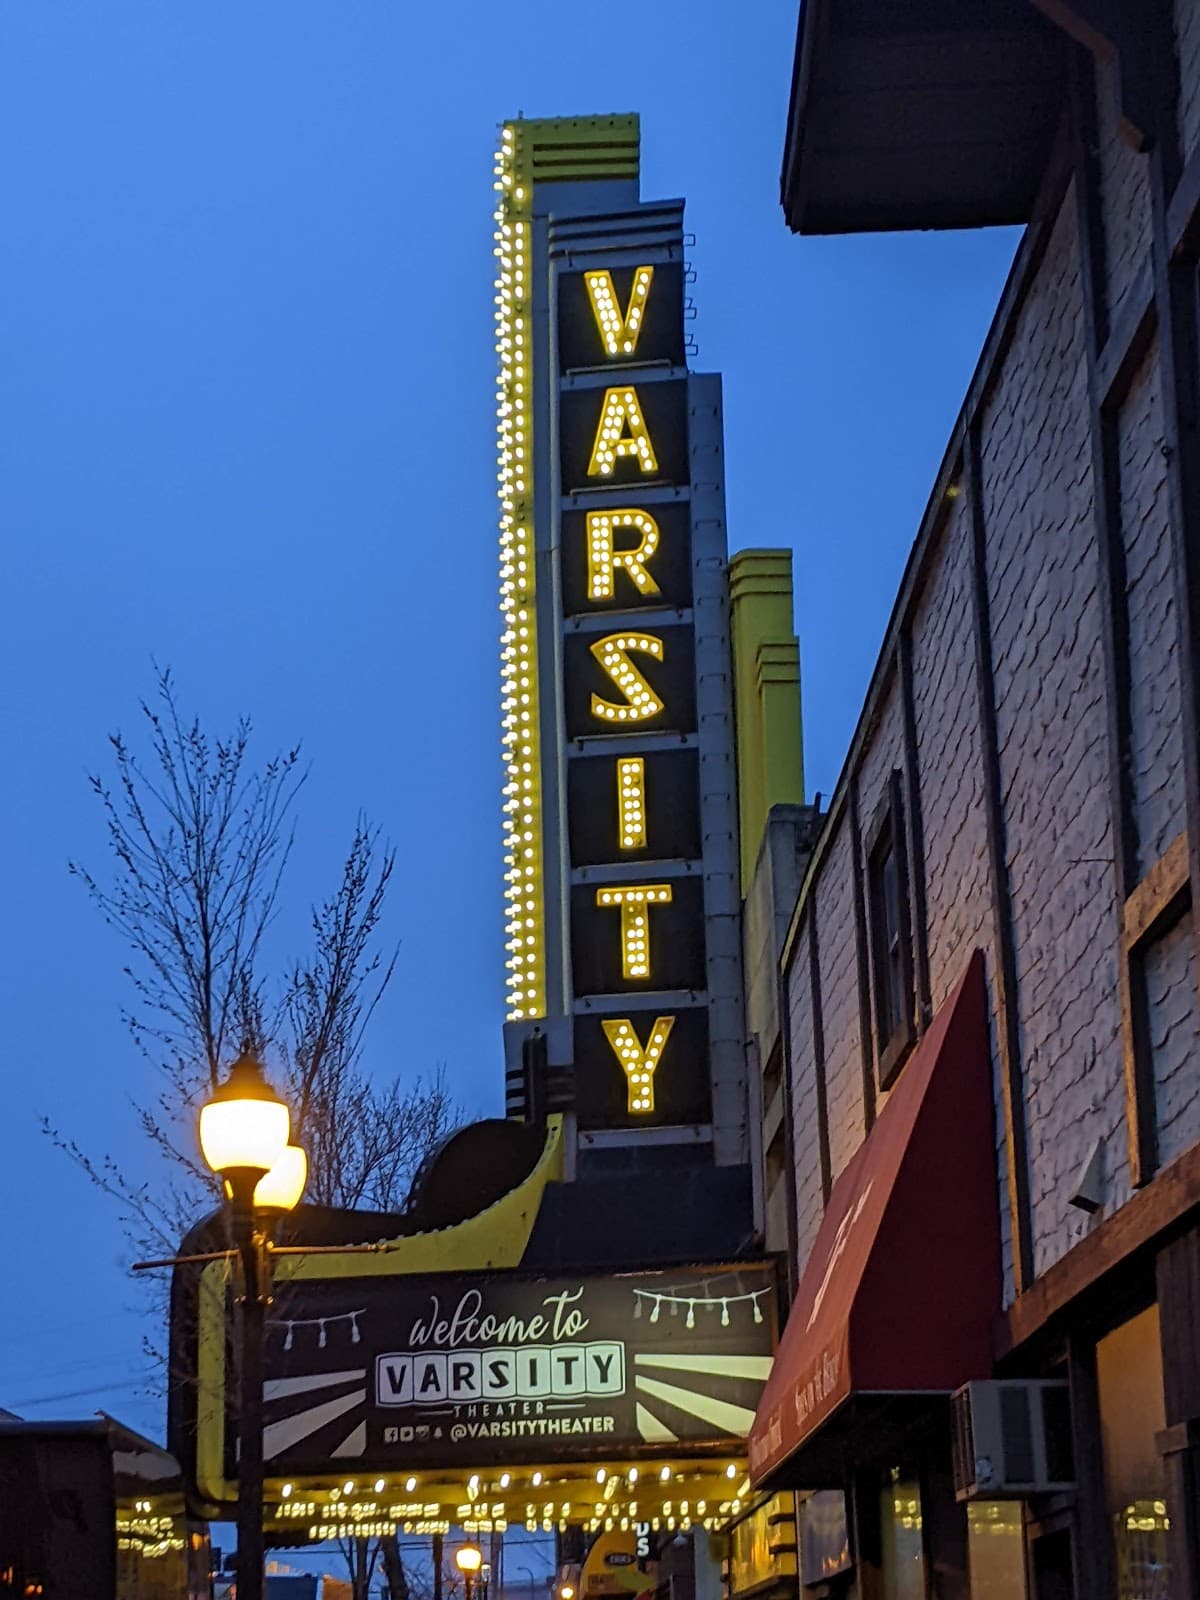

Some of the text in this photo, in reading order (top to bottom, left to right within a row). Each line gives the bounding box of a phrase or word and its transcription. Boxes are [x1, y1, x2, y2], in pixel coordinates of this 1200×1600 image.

[583, 265, 676, 1114] VARSITY
[385, 1353, 615, 1395] VARSITY
[452, 1401, 544, 1418] THEATER
[450, 1416, 615, 1442] @VARSITYTHEATER
